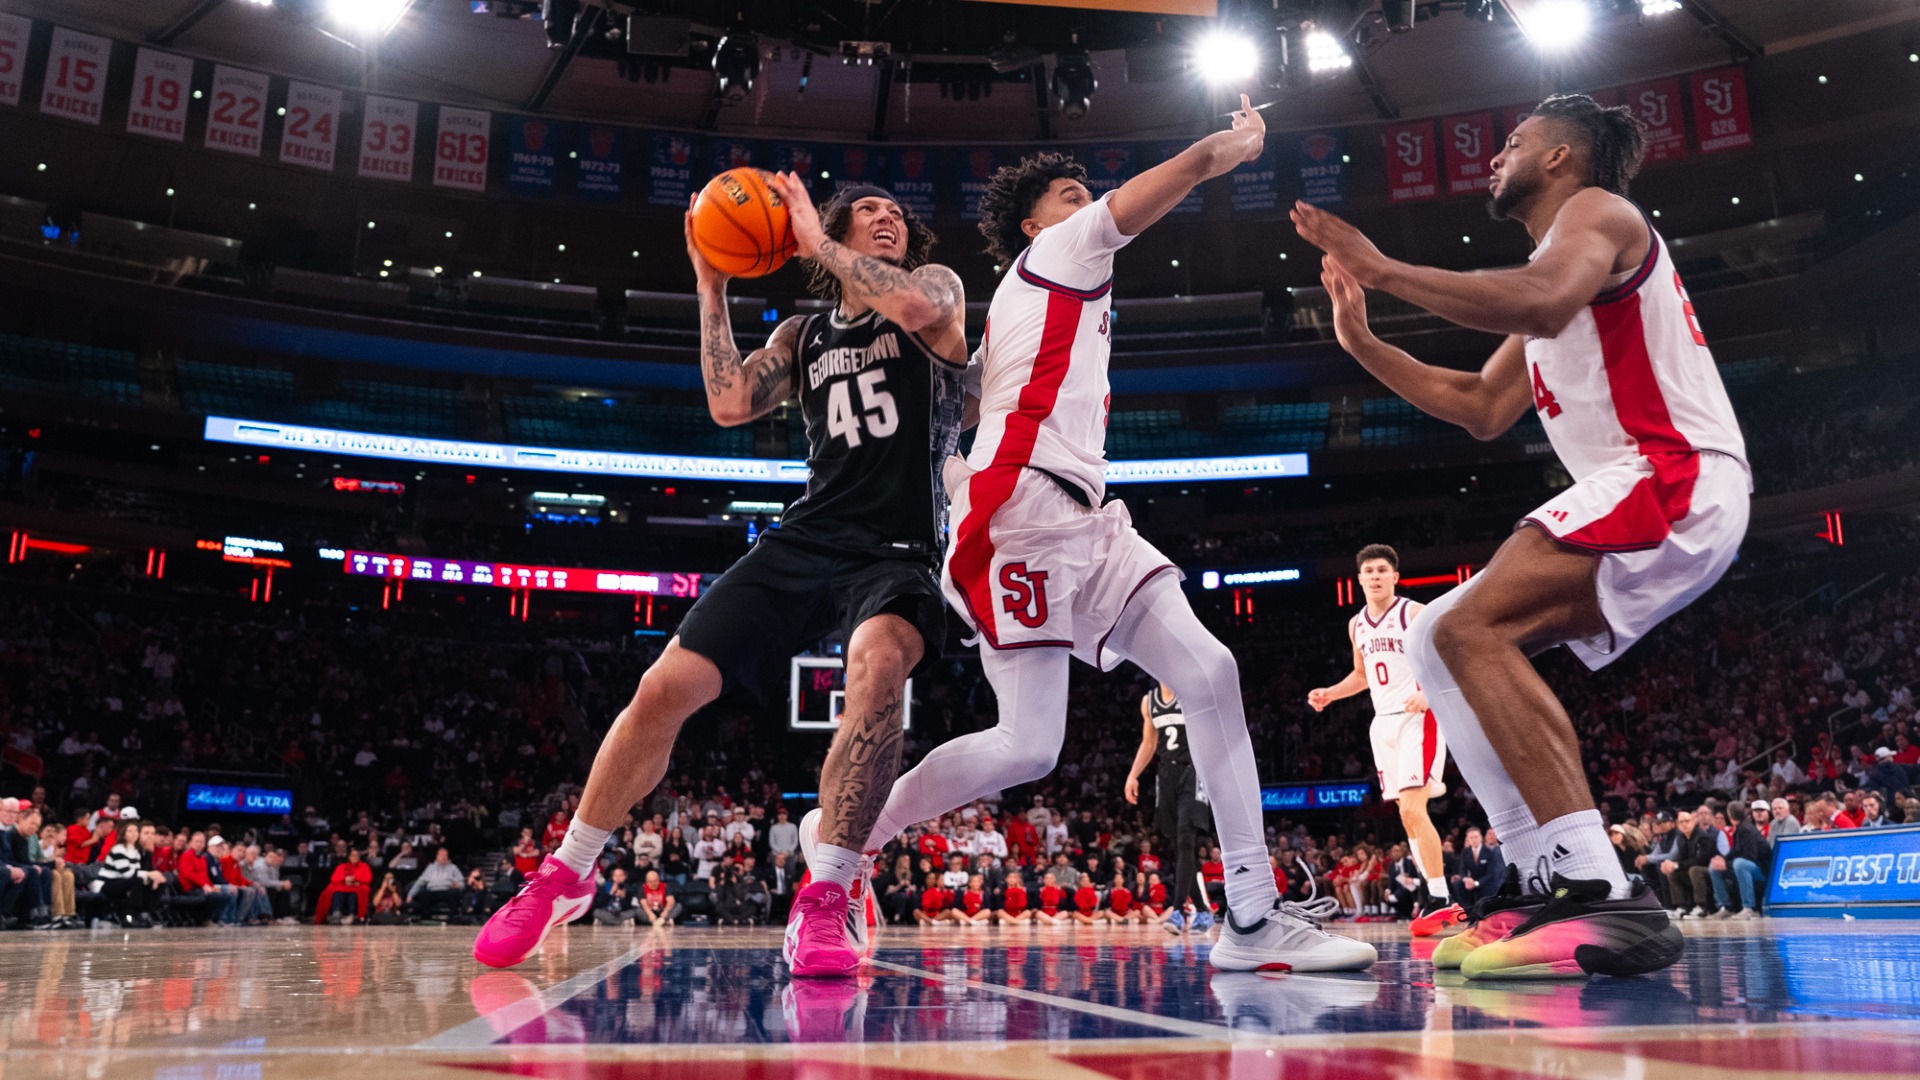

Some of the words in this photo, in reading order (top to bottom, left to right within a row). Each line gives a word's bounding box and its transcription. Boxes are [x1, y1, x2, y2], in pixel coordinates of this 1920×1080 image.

[56, 55, 97, 93] 15
[45, 92, 98, 118] KNICKS
[140, 75, 180, 112] 19
[214, 90, 260, 129] 22
[1639, 90, 1669, 127] SJ
[1703, 78, 1733, 115] SJ
[131, 111, 182, 135] KNICKS
[209, 127, 258, 150] KNICKS
[288, 106, 332, 143] 24
[367, 120, 411, 155] 33
[284, 142, 331, 165] KNICKS
[438, 131, 487, 164] 613
[1396, 131, 1423, 167] SJ
[1454, 123, 1481, 159] SJ
[362, 156, 409, 175] KNICKS
[437, 166, 483, 184] KNICKS
[808, 332, 901, 391] GEORGETOWN
[827, 367, 899, 449] 45
[999, 561, 1049, 628] SJ
[1369, 637, 1404, 654] JOHN'S
[1375, 661, 1389, 686] 0
[1165, 726, 1179, 751] 2
[247, 795, 290, 809] ULTRA
[1830, 853, 1894, 886] BEST
